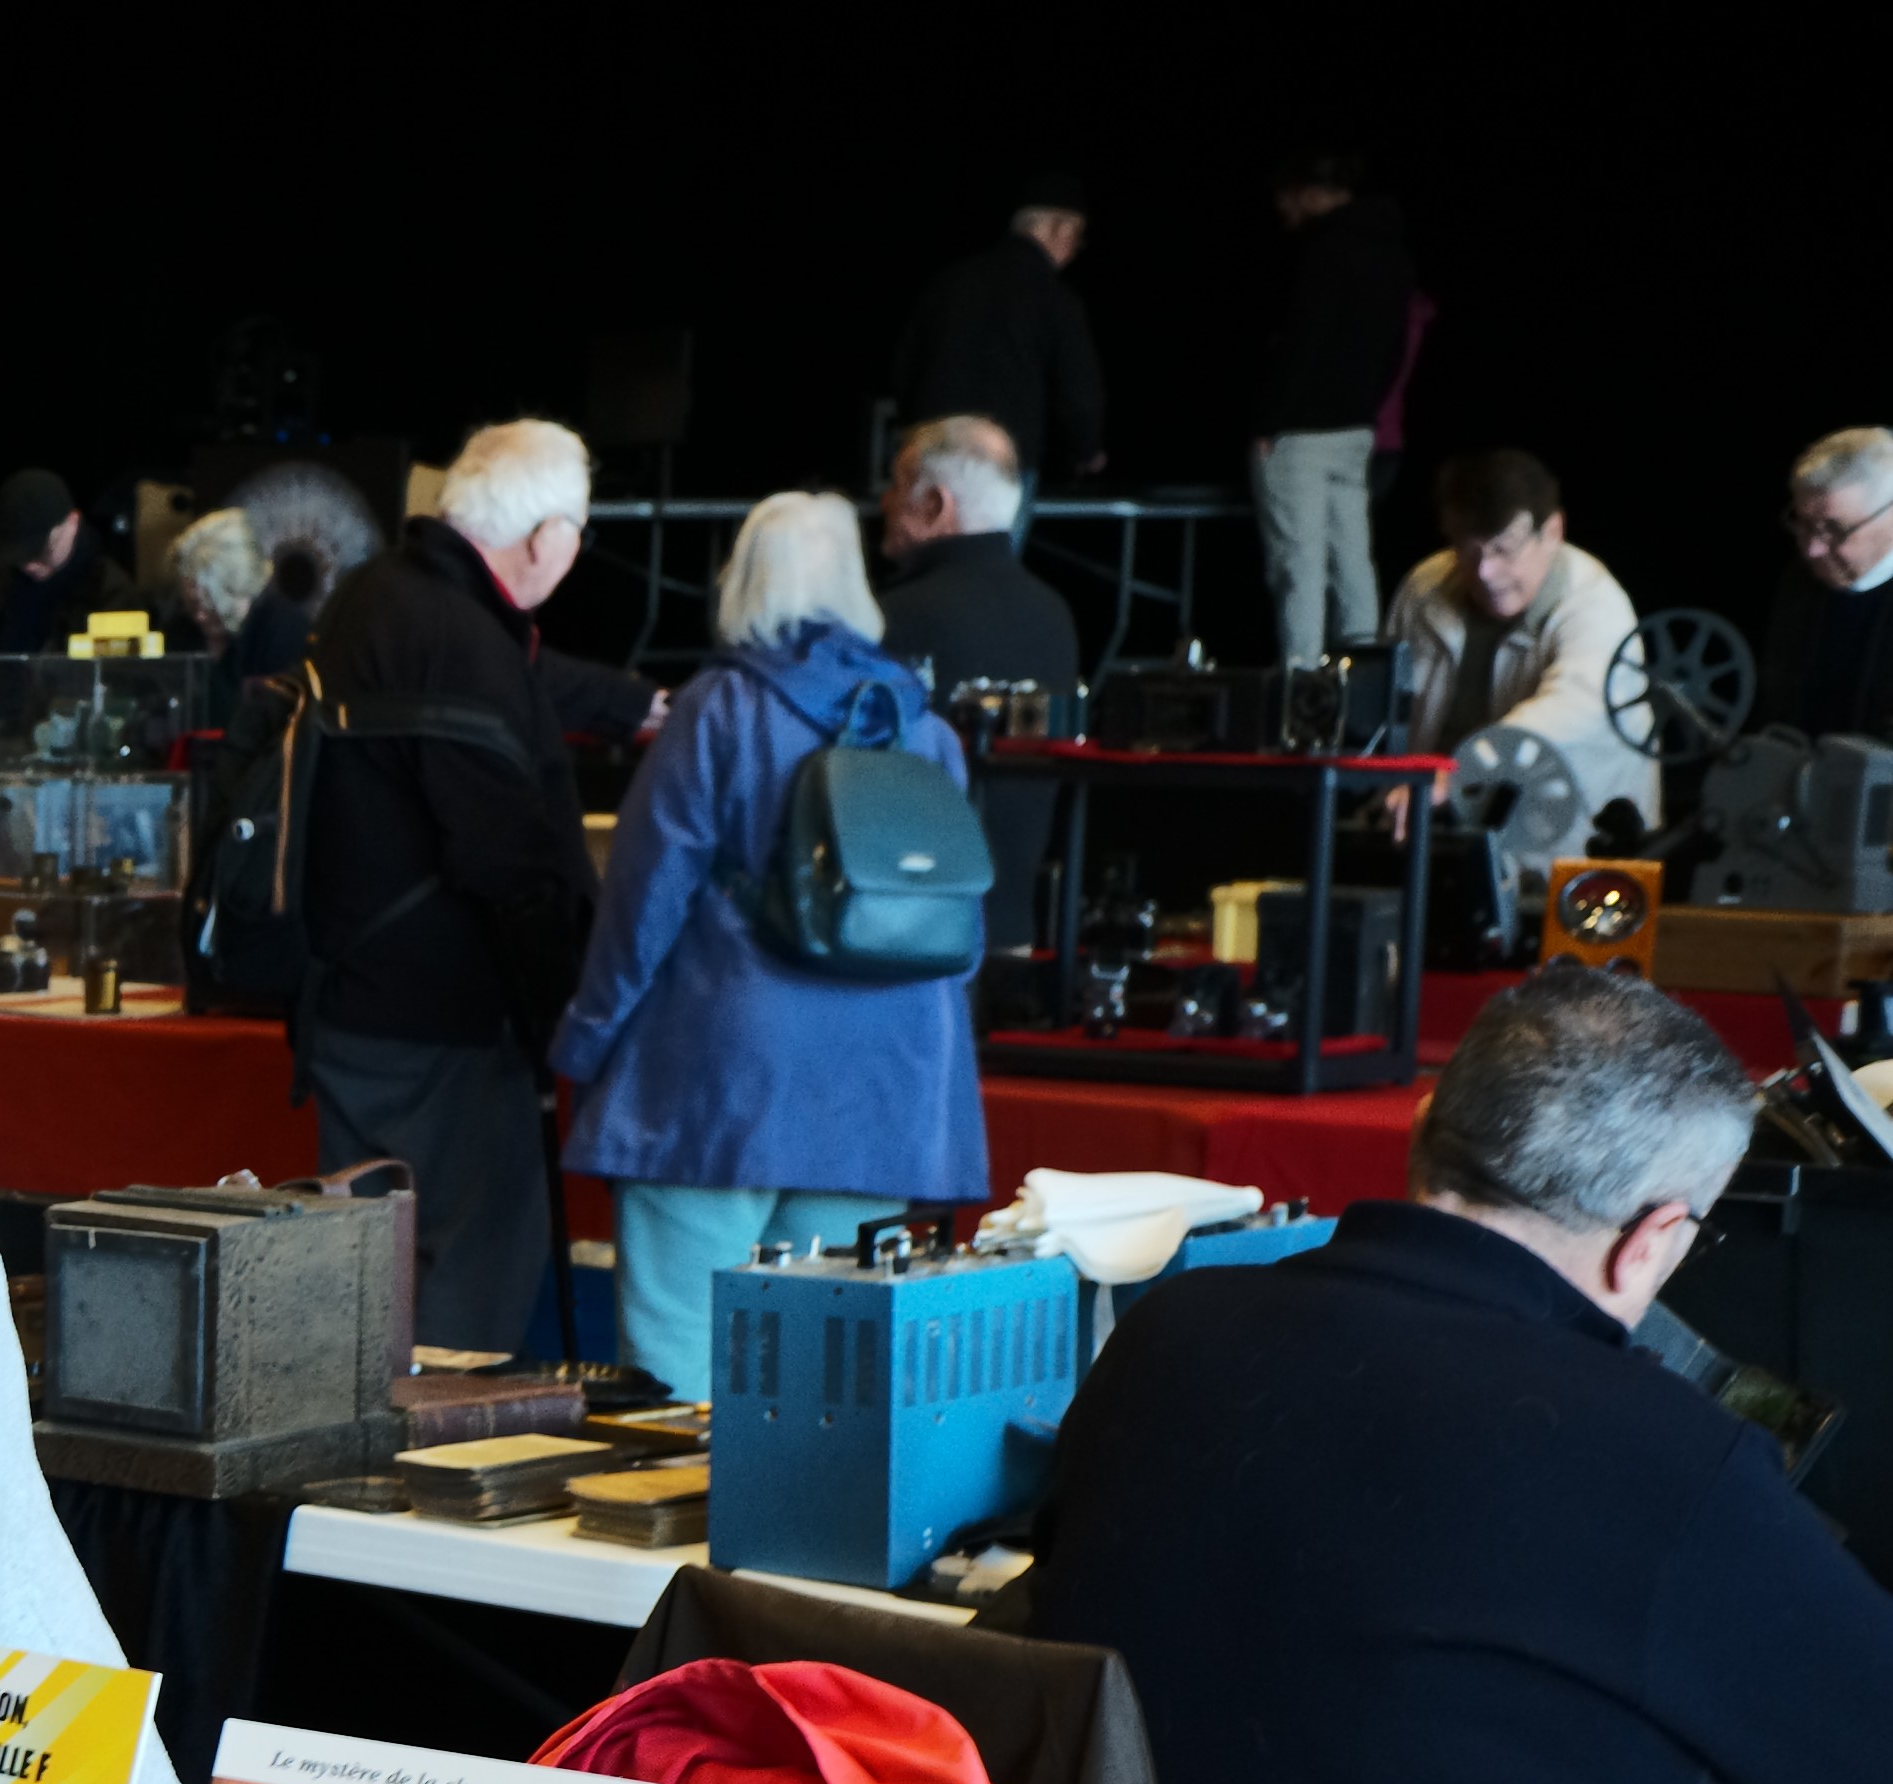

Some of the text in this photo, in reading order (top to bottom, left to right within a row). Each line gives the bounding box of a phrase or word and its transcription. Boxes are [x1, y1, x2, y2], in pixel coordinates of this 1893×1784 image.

[34, 1752, 53, 1784] F
[270, 1751, 291, 1769] Le
[299, 1756, 380, 1783] mystère
